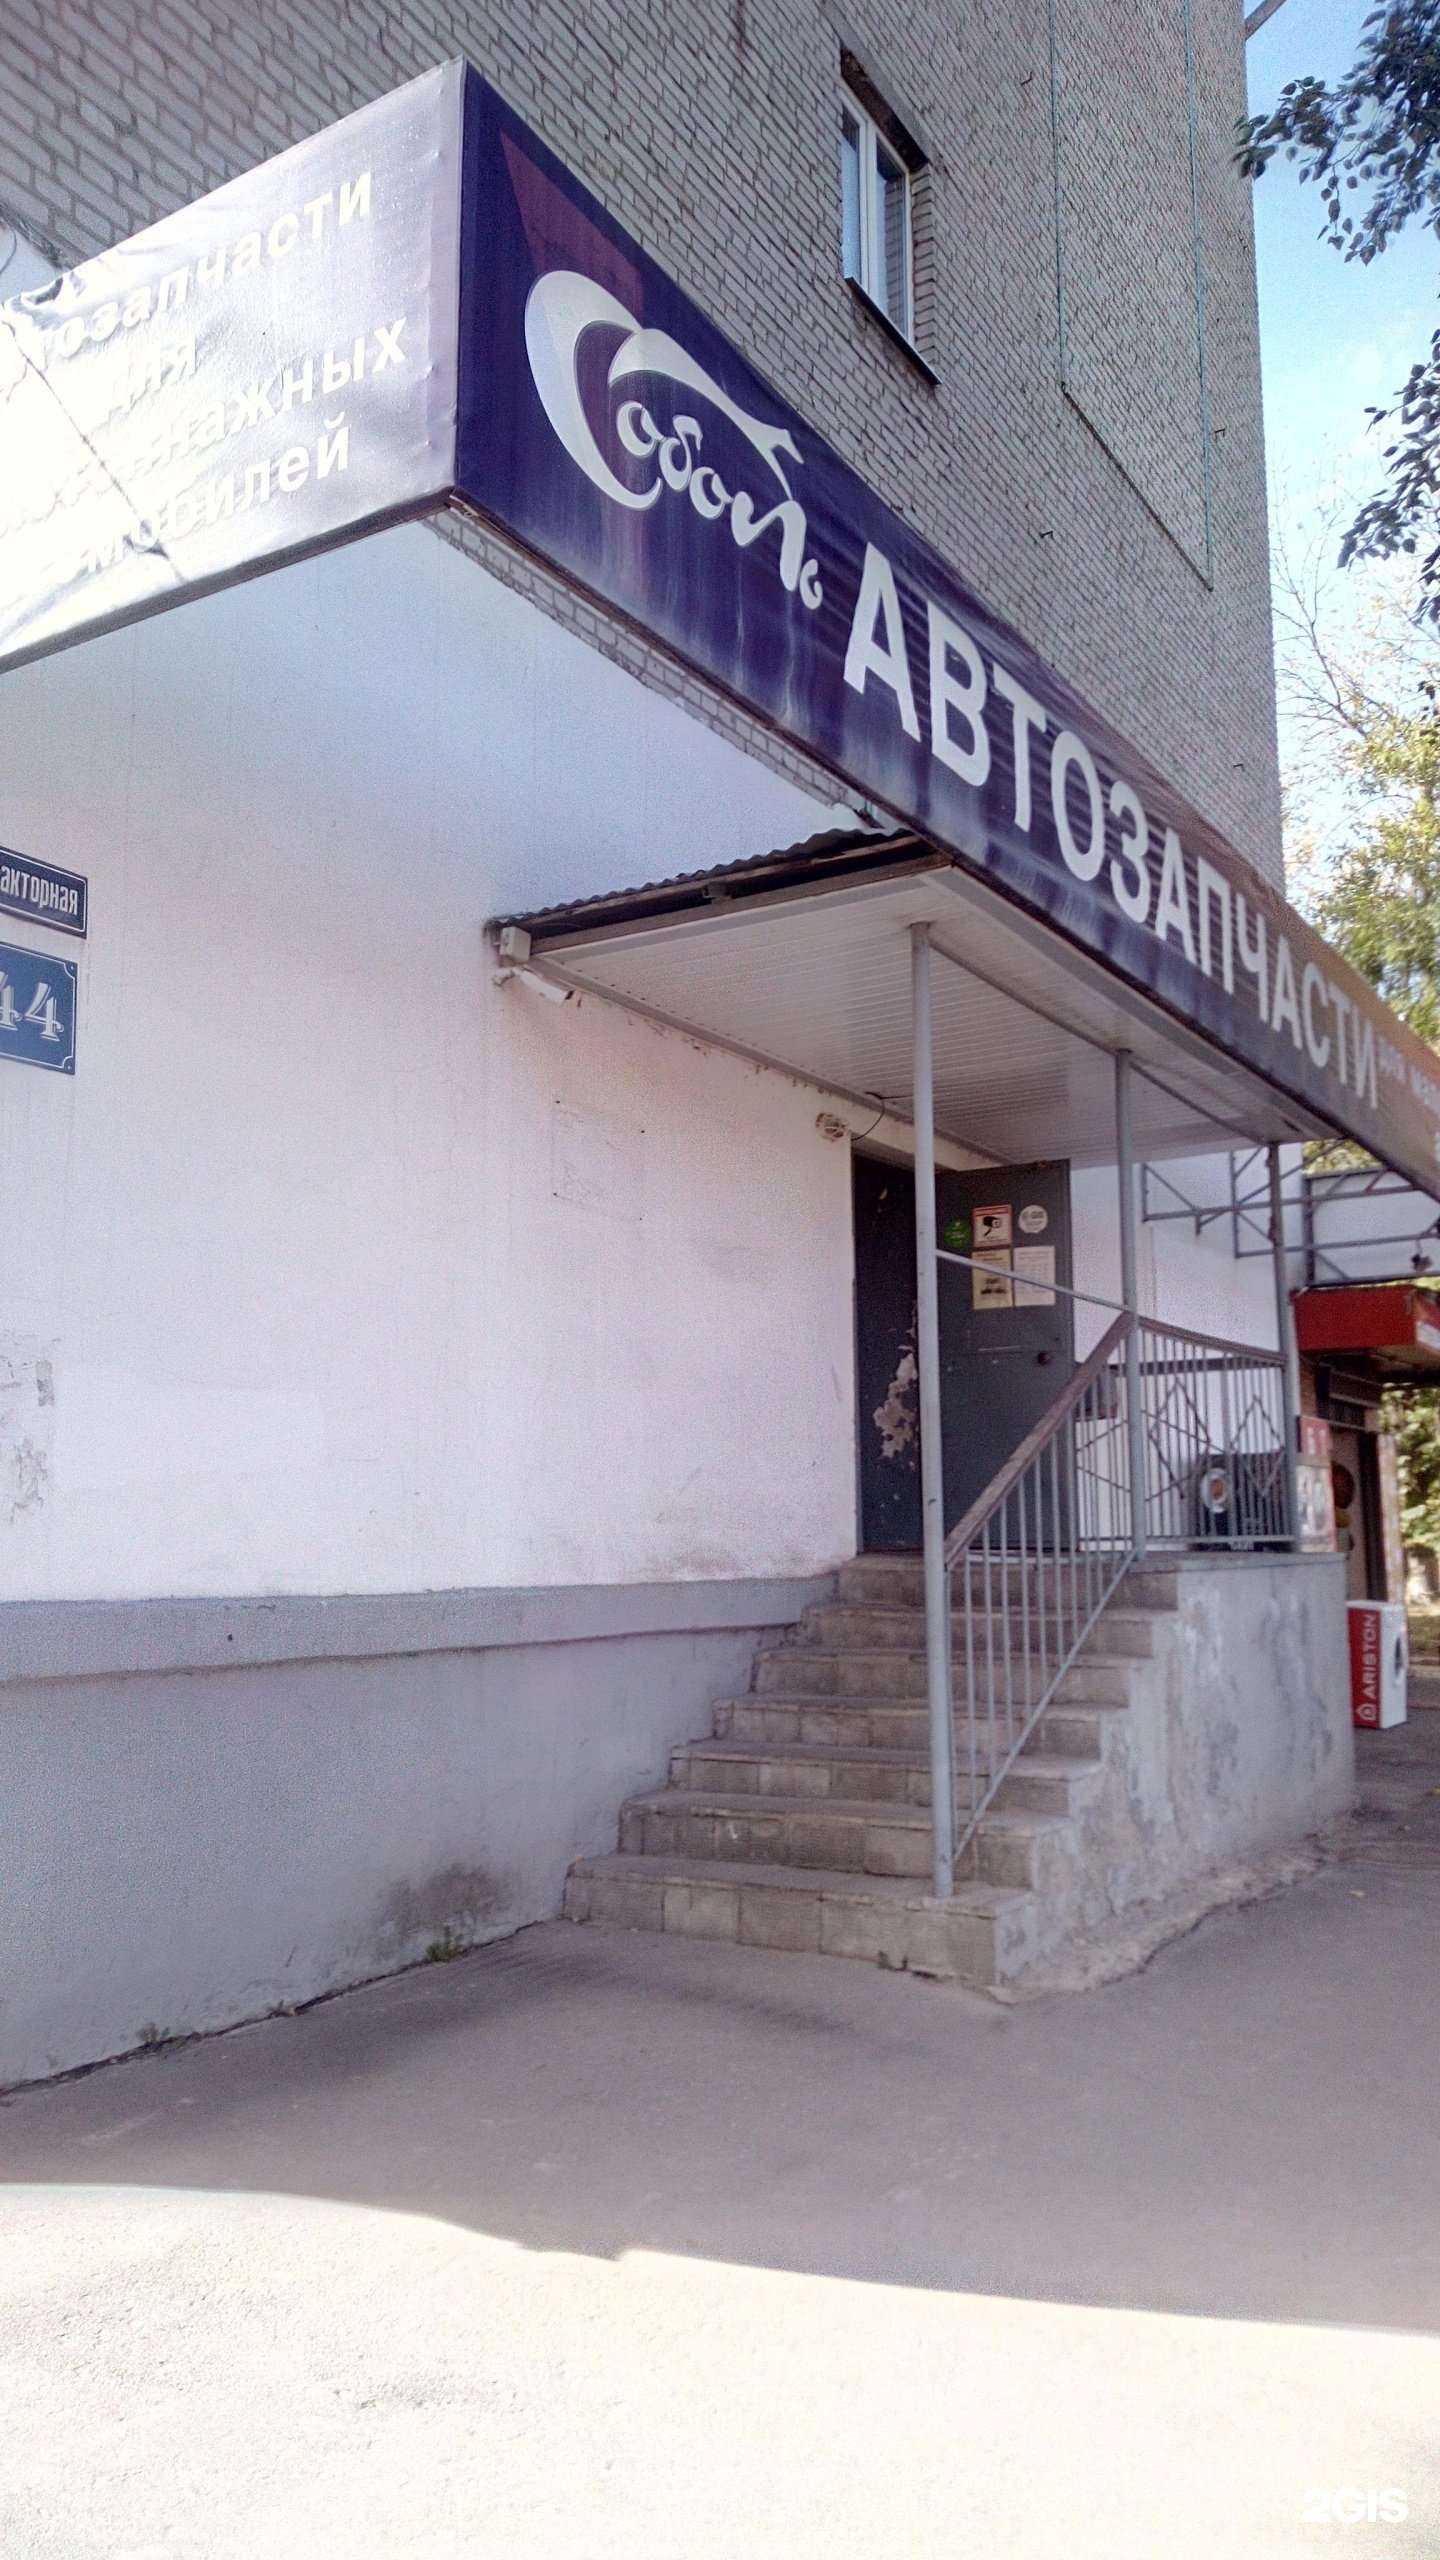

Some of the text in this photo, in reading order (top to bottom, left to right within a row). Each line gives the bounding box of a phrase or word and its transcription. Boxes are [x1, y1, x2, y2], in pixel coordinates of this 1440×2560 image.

[45, 170, 374, 362] озапчасти
[0, 866, 79, 916] акторная
[843, 541, 1379, 1109] АВТОЗАПЧАСТИ
[1362, 1614, 1377, 1700] ARISTON
